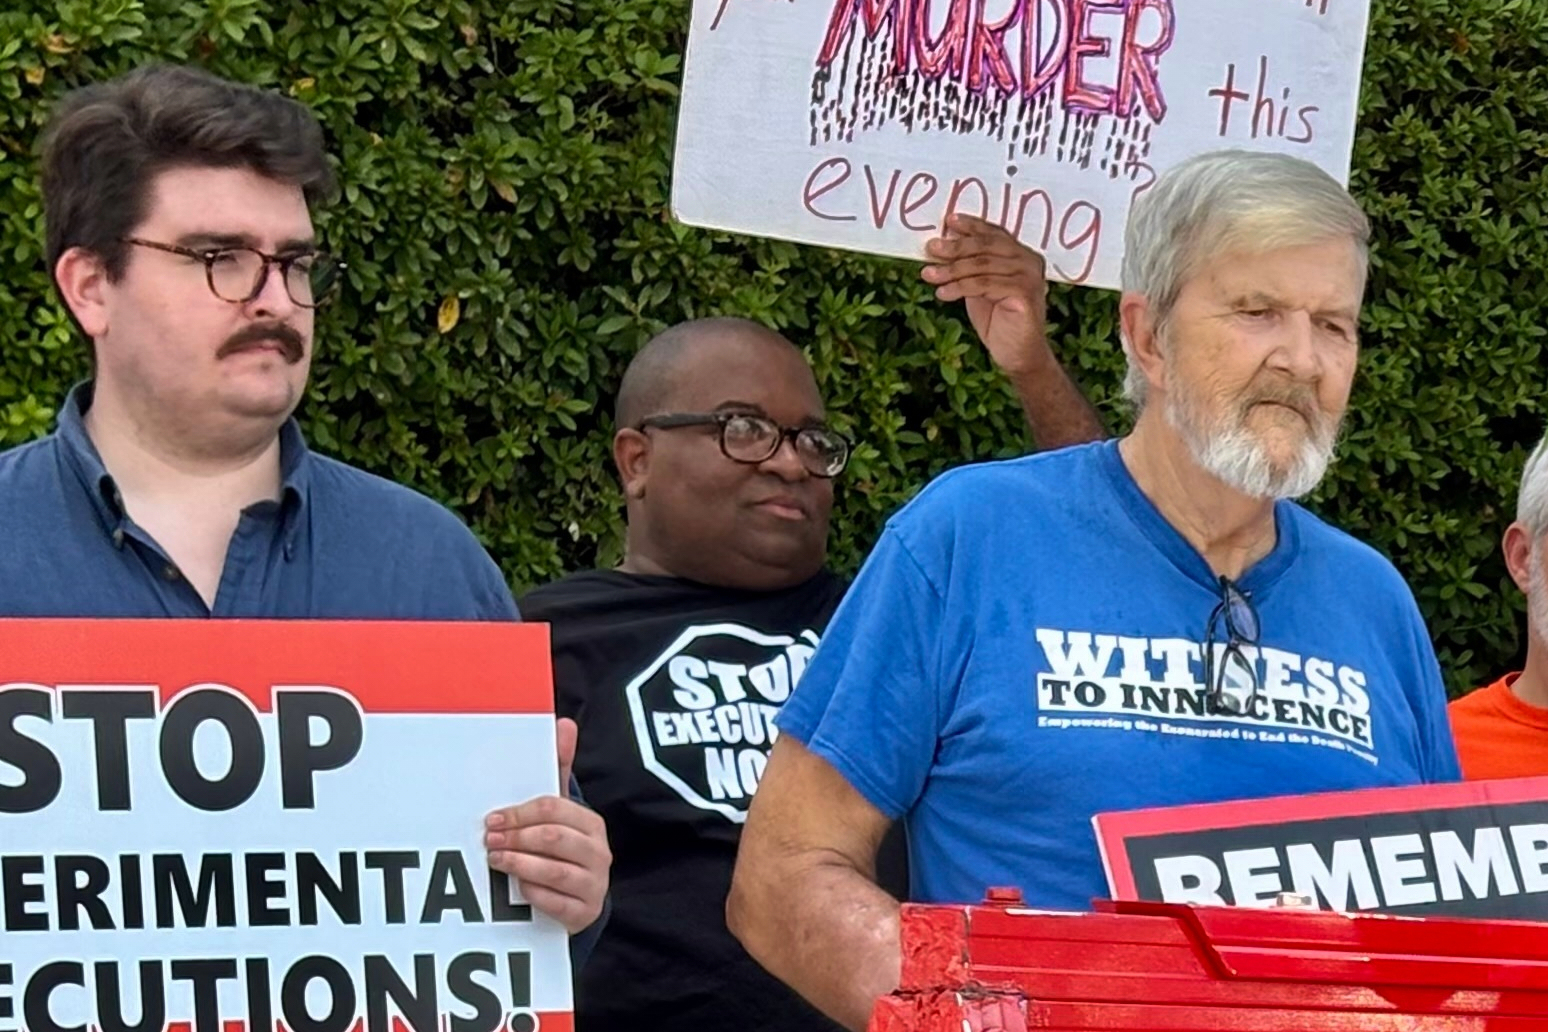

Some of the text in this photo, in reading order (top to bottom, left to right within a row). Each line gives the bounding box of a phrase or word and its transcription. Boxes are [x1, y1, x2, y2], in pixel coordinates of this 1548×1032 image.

[1209, 55, 1318, 142] this
[1035, 628, 1371, 714] WITNESS
[1043, 679, 1106, 708] TO
[0, 687, 364, 813] STOP
